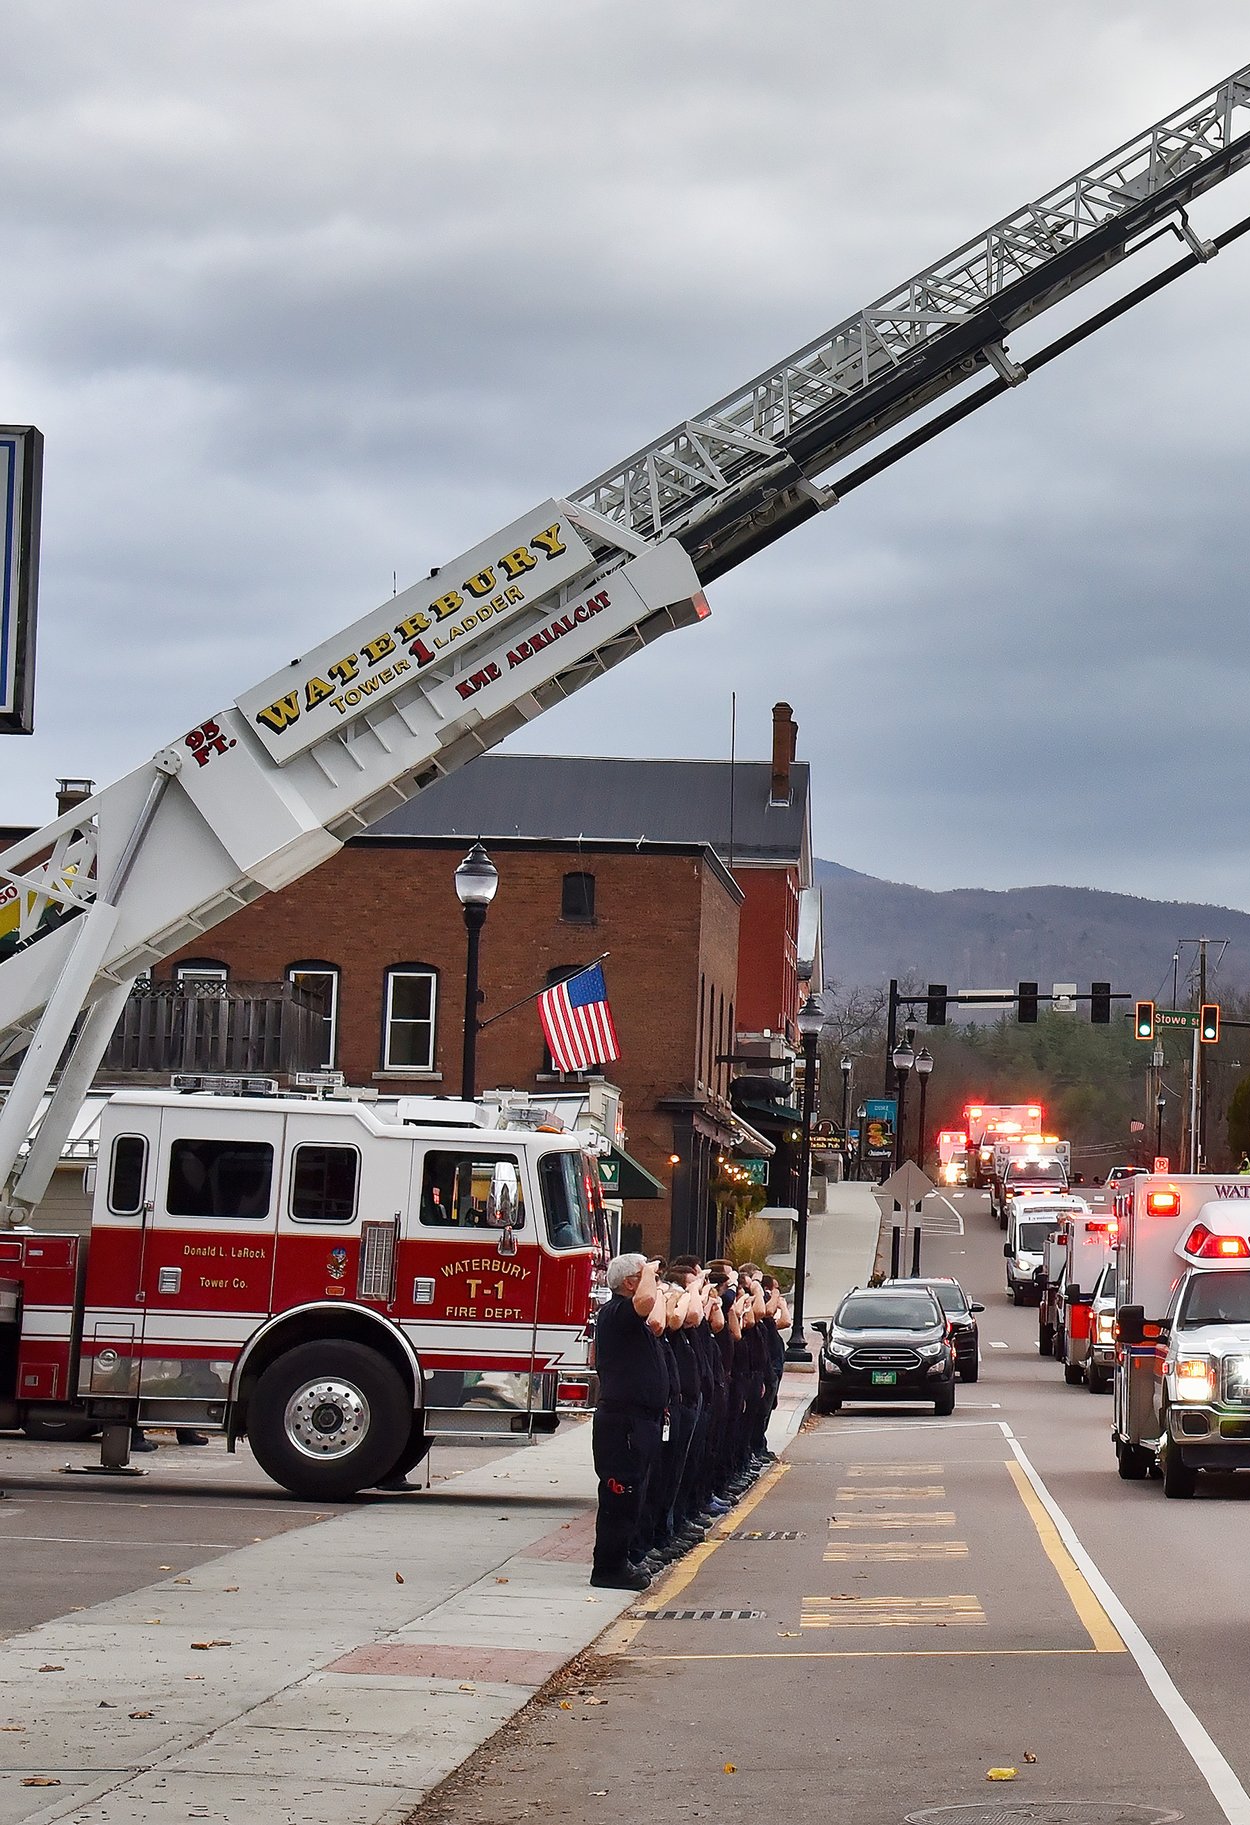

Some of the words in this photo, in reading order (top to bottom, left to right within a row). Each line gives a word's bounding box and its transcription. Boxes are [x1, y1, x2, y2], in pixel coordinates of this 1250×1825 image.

[256, 523, 566, 735] WATERBURY
[329, 658, 411, 714] TOWER
[408, 638, 436, 669] 1
[434, 584, 525, 649] LADDER
[455, 662, 502, 700] KME
[506, 590, 611, 669] AERIALCAT
[185, 720, 220, 751] 95
[192, 734, 237, 768] FT.
[1155, 1013, 1187, 1025] Stowe
[183, 1245, 216, 1257] Donald
[219, 1246, 228, 1257] L.
[231, 1247, 266, 1258] LaRock
[441, 1258, 531, 1280] WATERBURY
[200, 1277, 228, 1288] Tower
[232, 1278, 248, 1288] Co.
[466, 1279, 504, 1299] T-1
[446, 1306, 477, 1317] FIRE
[484, 1307, 523, 1319] DEPT.
